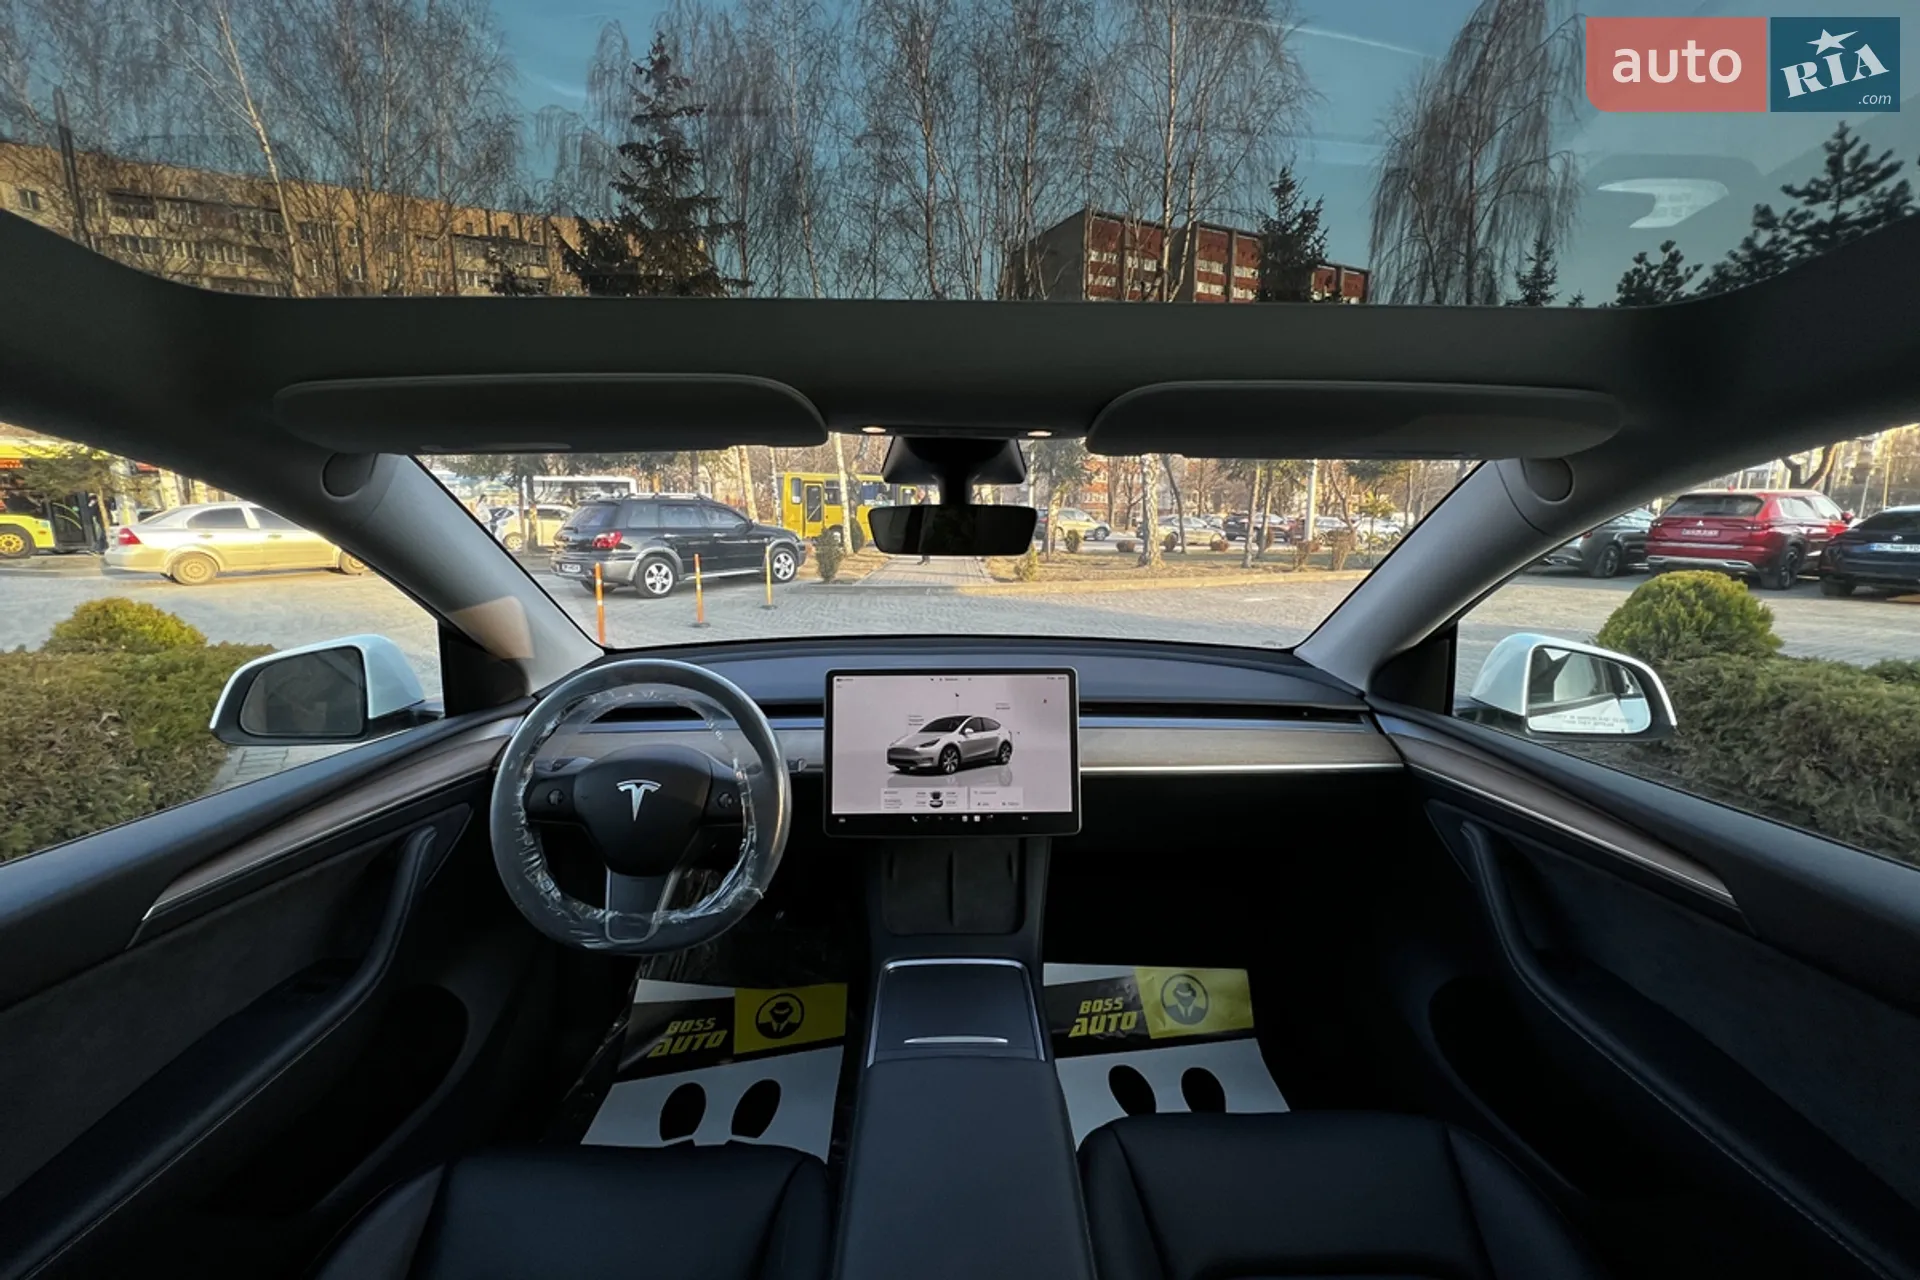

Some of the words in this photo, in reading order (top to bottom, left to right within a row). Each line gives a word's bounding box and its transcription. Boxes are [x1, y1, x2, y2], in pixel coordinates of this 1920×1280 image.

[1079, 996, 1124, 1015] BOSS
[664, 1017, 717, 1035] BOSS
[1068, 1011, 1137, 1038] AUTO
[646, 1029, 728, 1058] AUTO
